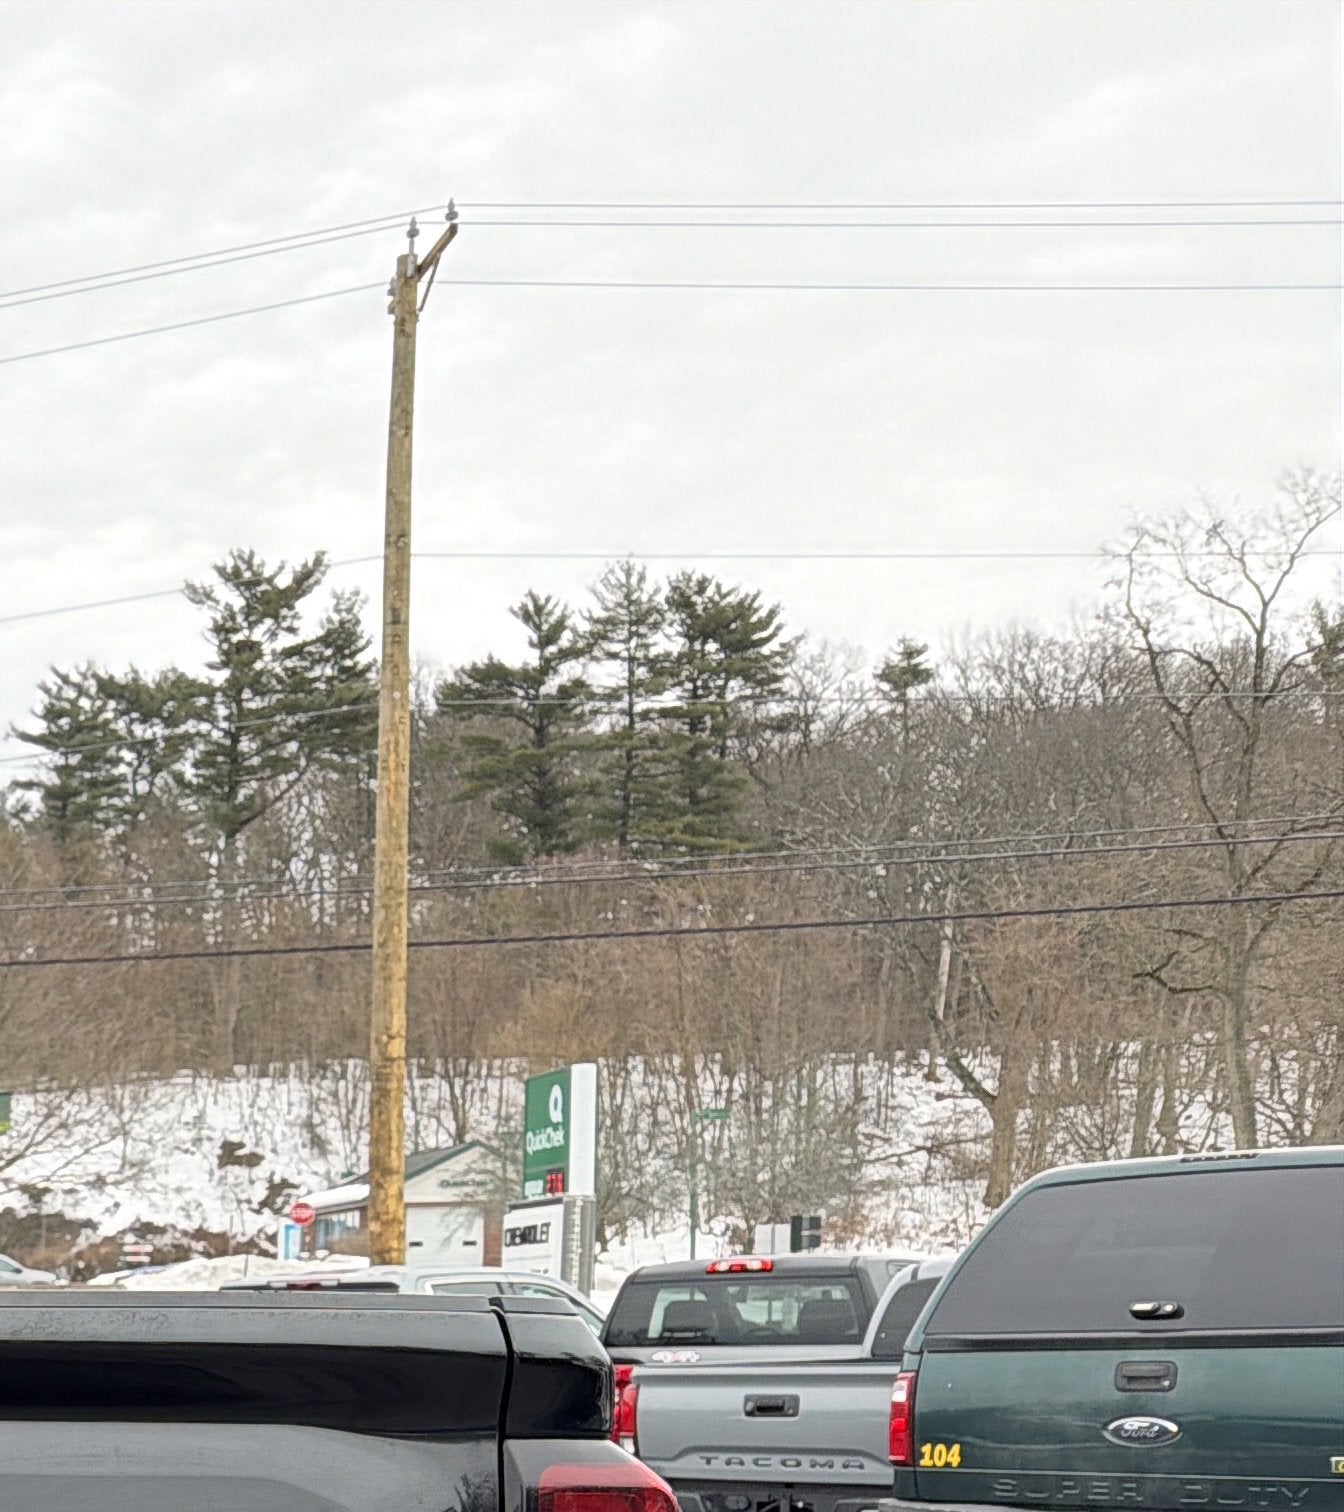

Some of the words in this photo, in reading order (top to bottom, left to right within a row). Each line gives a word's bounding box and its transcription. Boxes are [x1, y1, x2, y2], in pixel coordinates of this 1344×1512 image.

[1120, 1421, 1160, 1438] Ford
[699, 1455, 865, 1470] TACOMA
[919, 1443, 961, 1468] 104
[993, 1478, 1144, 1502] SUPER
[1179, 1484, 1310, 1507] DUTY
